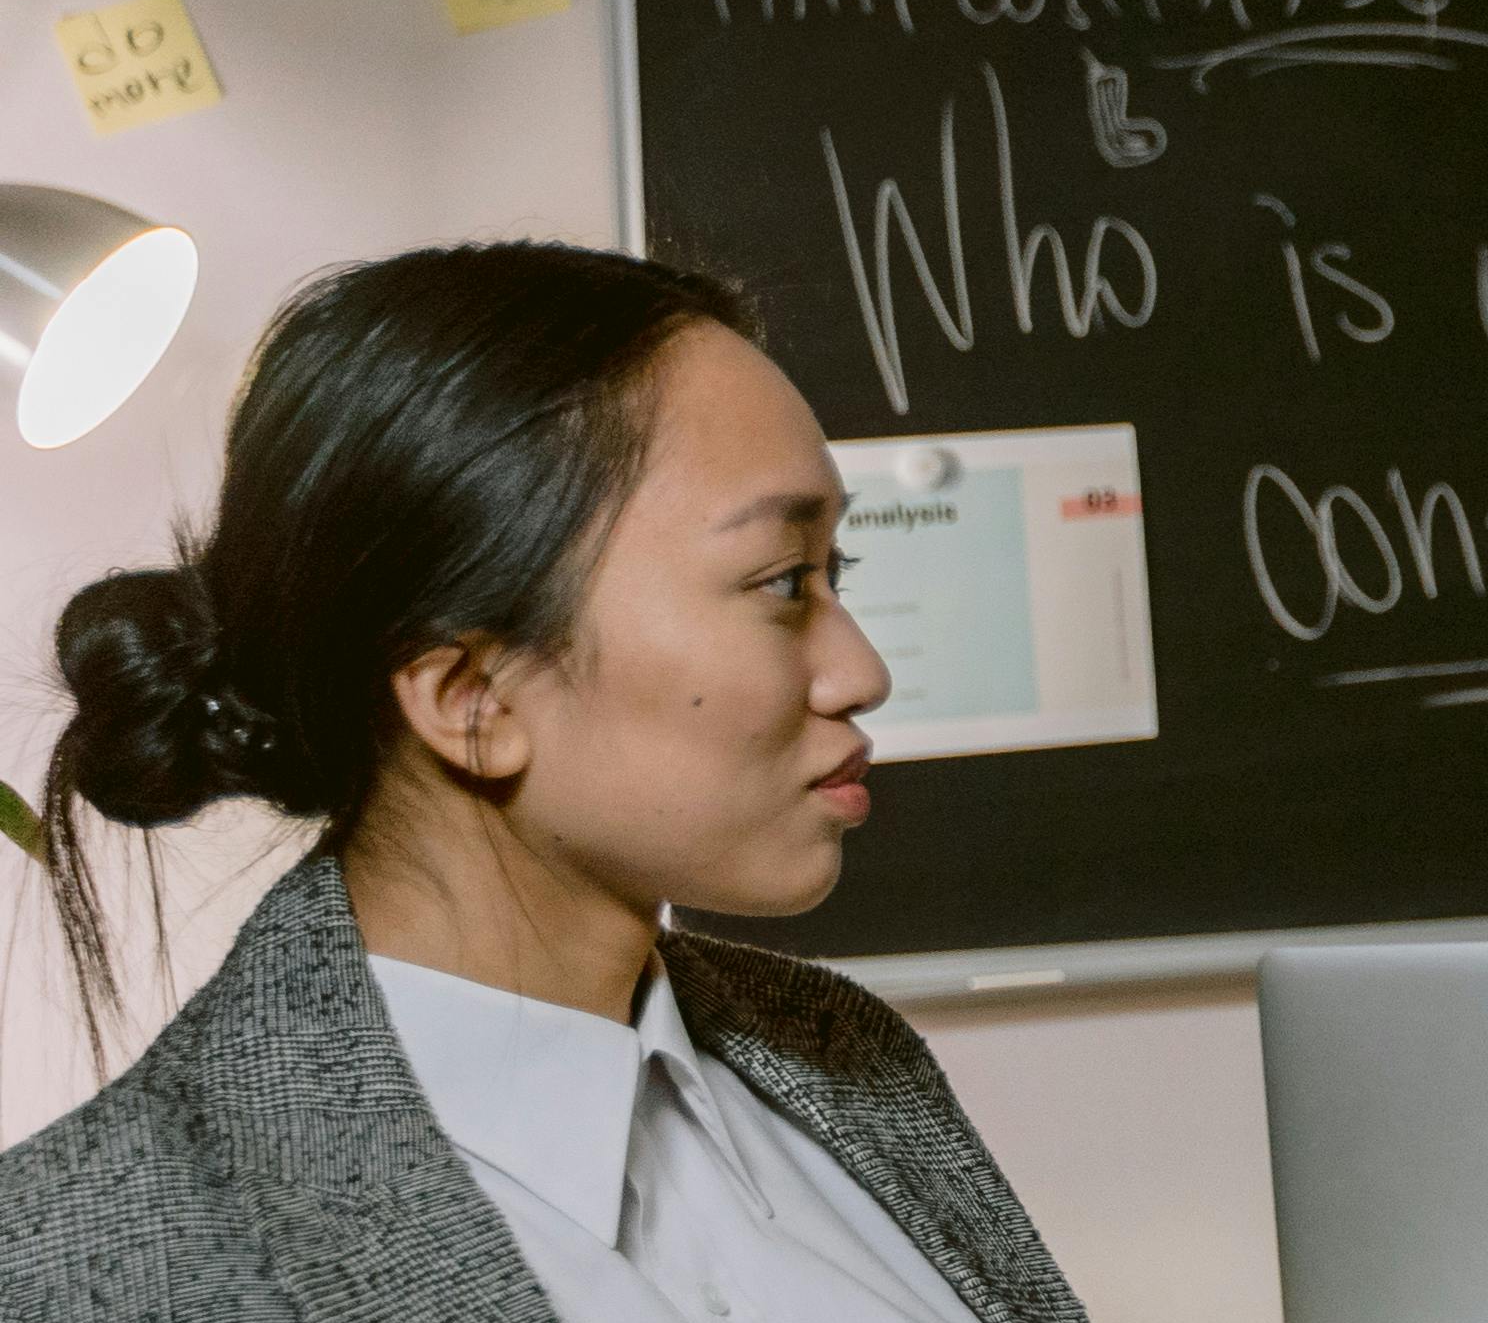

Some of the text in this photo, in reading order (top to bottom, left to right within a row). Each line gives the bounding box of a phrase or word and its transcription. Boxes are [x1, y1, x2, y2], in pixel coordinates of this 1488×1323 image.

[76, 12, 164, 76] do
[91, 57, 200, 115] more
[820, 62, 1157, 413] Who
[1253, 195, 1395, 361] is
[847, 502, 959, 532] analysis
